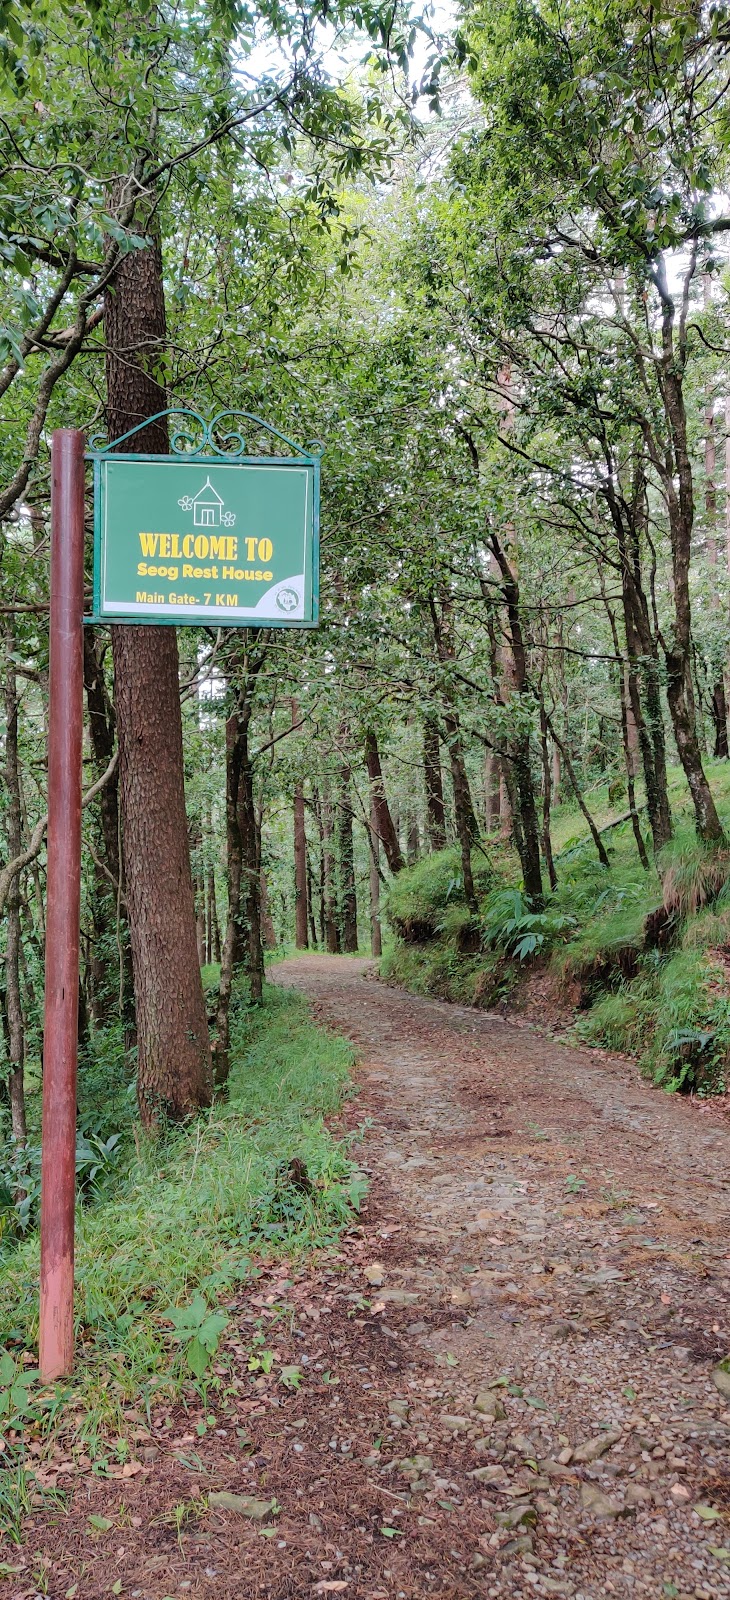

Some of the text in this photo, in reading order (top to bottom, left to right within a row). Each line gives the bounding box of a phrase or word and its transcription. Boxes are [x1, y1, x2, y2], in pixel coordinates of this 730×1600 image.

[138, 532, 273, 562] WELCOME TO
[137, 562, 273, 581] Seog Rest House
[135, 591, 238, 607] Main Gate- 7 KM
